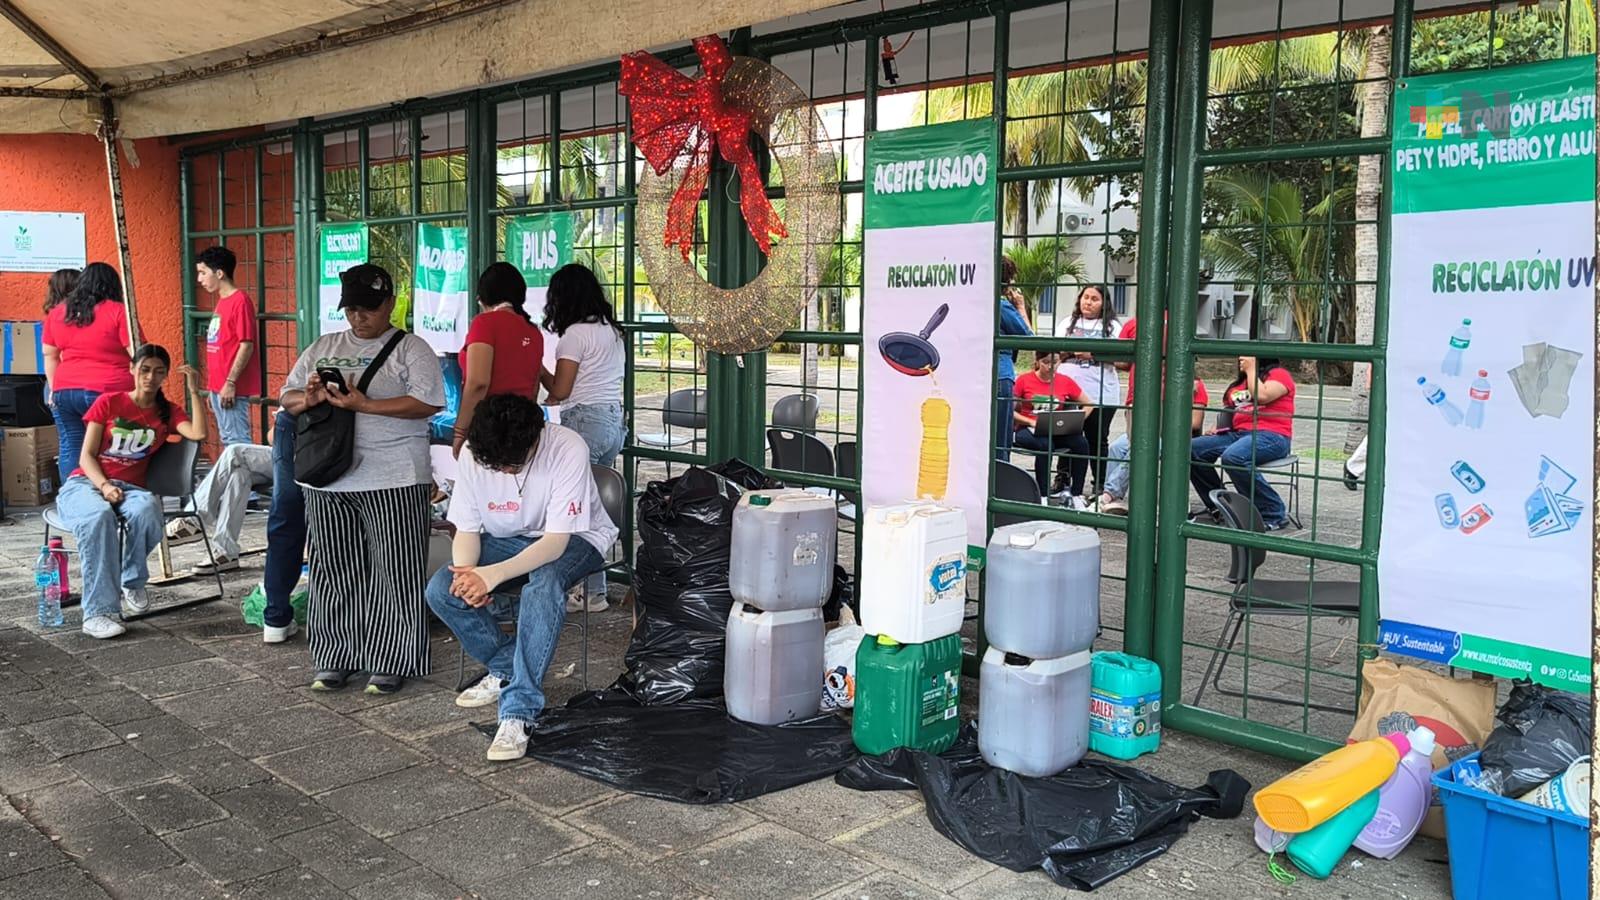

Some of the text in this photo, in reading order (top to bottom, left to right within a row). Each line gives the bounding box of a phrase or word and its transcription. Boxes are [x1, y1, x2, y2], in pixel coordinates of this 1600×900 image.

[873, 152, 987, 195] ACEITE USADO
[1396, 147, 1422, 172] PET
[1423, 147, 1435, 169] Y
[1438, 143, 1484, 170] HDPE,
[1487, 136, 1540, 164] FIERRO
[1543, 133, 1556, 159] Y
[522, 229, 558, 271] PILAS
[1432, 249, 1595, 293] RECICLATÓN UV
[887, 256, 976, 288] RECICLATÓN UV
